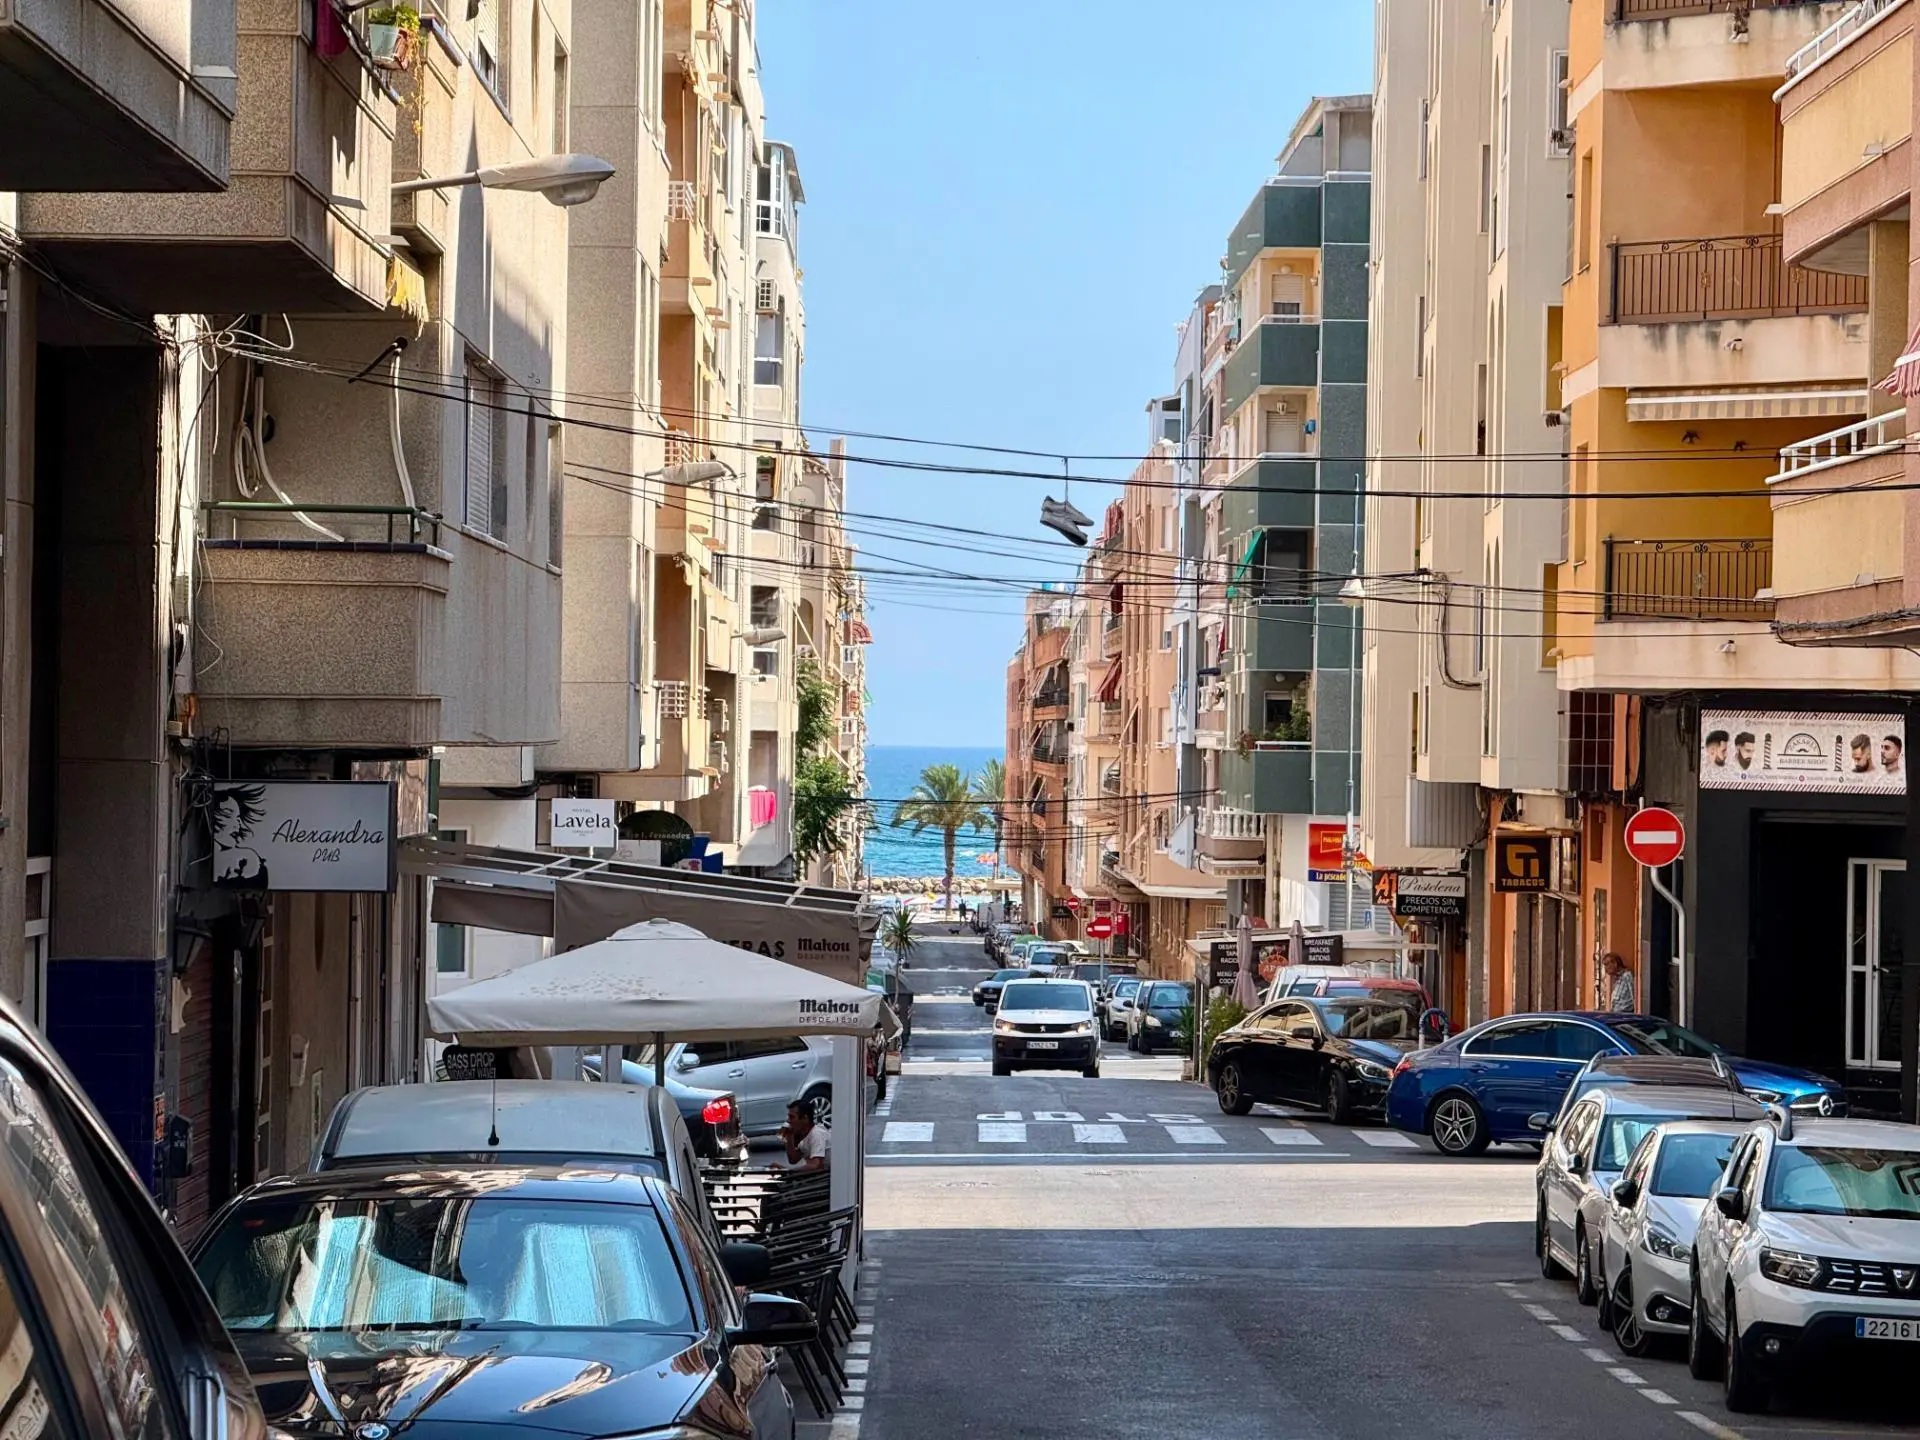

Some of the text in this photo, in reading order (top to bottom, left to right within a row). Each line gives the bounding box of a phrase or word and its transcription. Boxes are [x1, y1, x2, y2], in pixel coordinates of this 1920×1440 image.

[555, 813, 610, 828] Lavela
[272, 819, 384, 844] Alexandra
[313, 848, 340, 862] PUB
[1406, 896, 1456, 906] PRECIOS SIN
[1401, 905, 1460, 914] COMPETENCIA
[798, 938, 850, 952] Mahou
[1305, 938, 1334, 946] BREAKFAST
[800, 999, 859, 1013] Mahou
[799, 1016, 831, 1024] DESDE
[447, 1051, 495, 1069] BASS DROP
[1868, 1320, 1910, 1338] 2216
